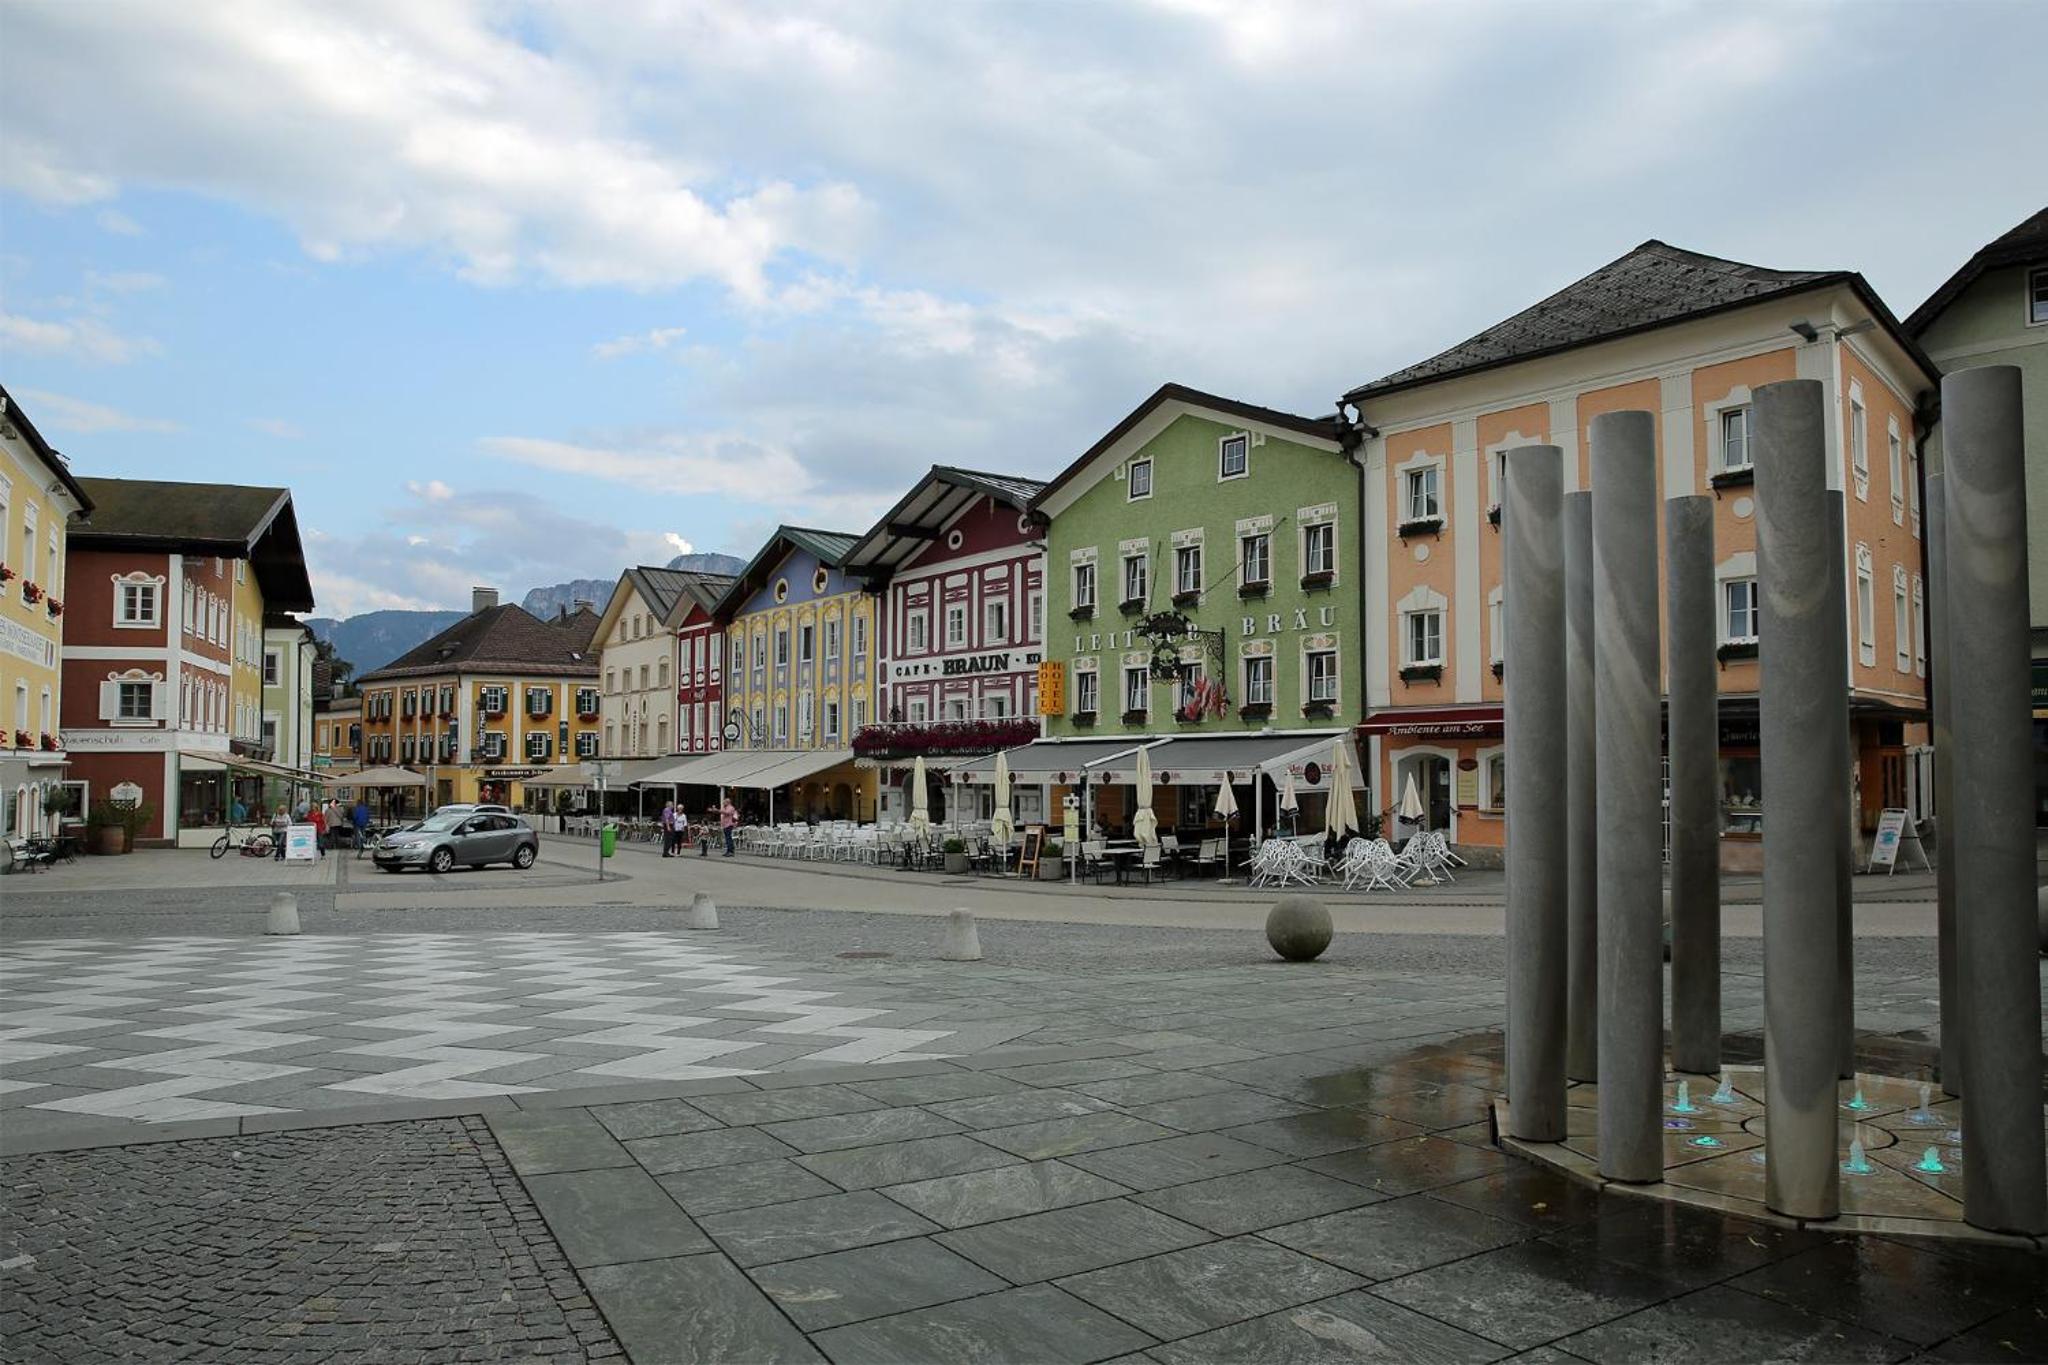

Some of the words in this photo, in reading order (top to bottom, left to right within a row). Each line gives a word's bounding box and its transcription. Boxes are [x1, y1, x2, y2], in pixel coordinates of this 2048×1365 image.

[1242, 606, 1337, 636] BRÄU
[942, 653, 1010, 676] BRAUN
[1040, 661, 1048, 708] HOTEL
[1052, 661, 1063, 708] HOTEL
[1387, 724, 1441, 736] Ambiente
[1462, 722, 1484, 733] See
